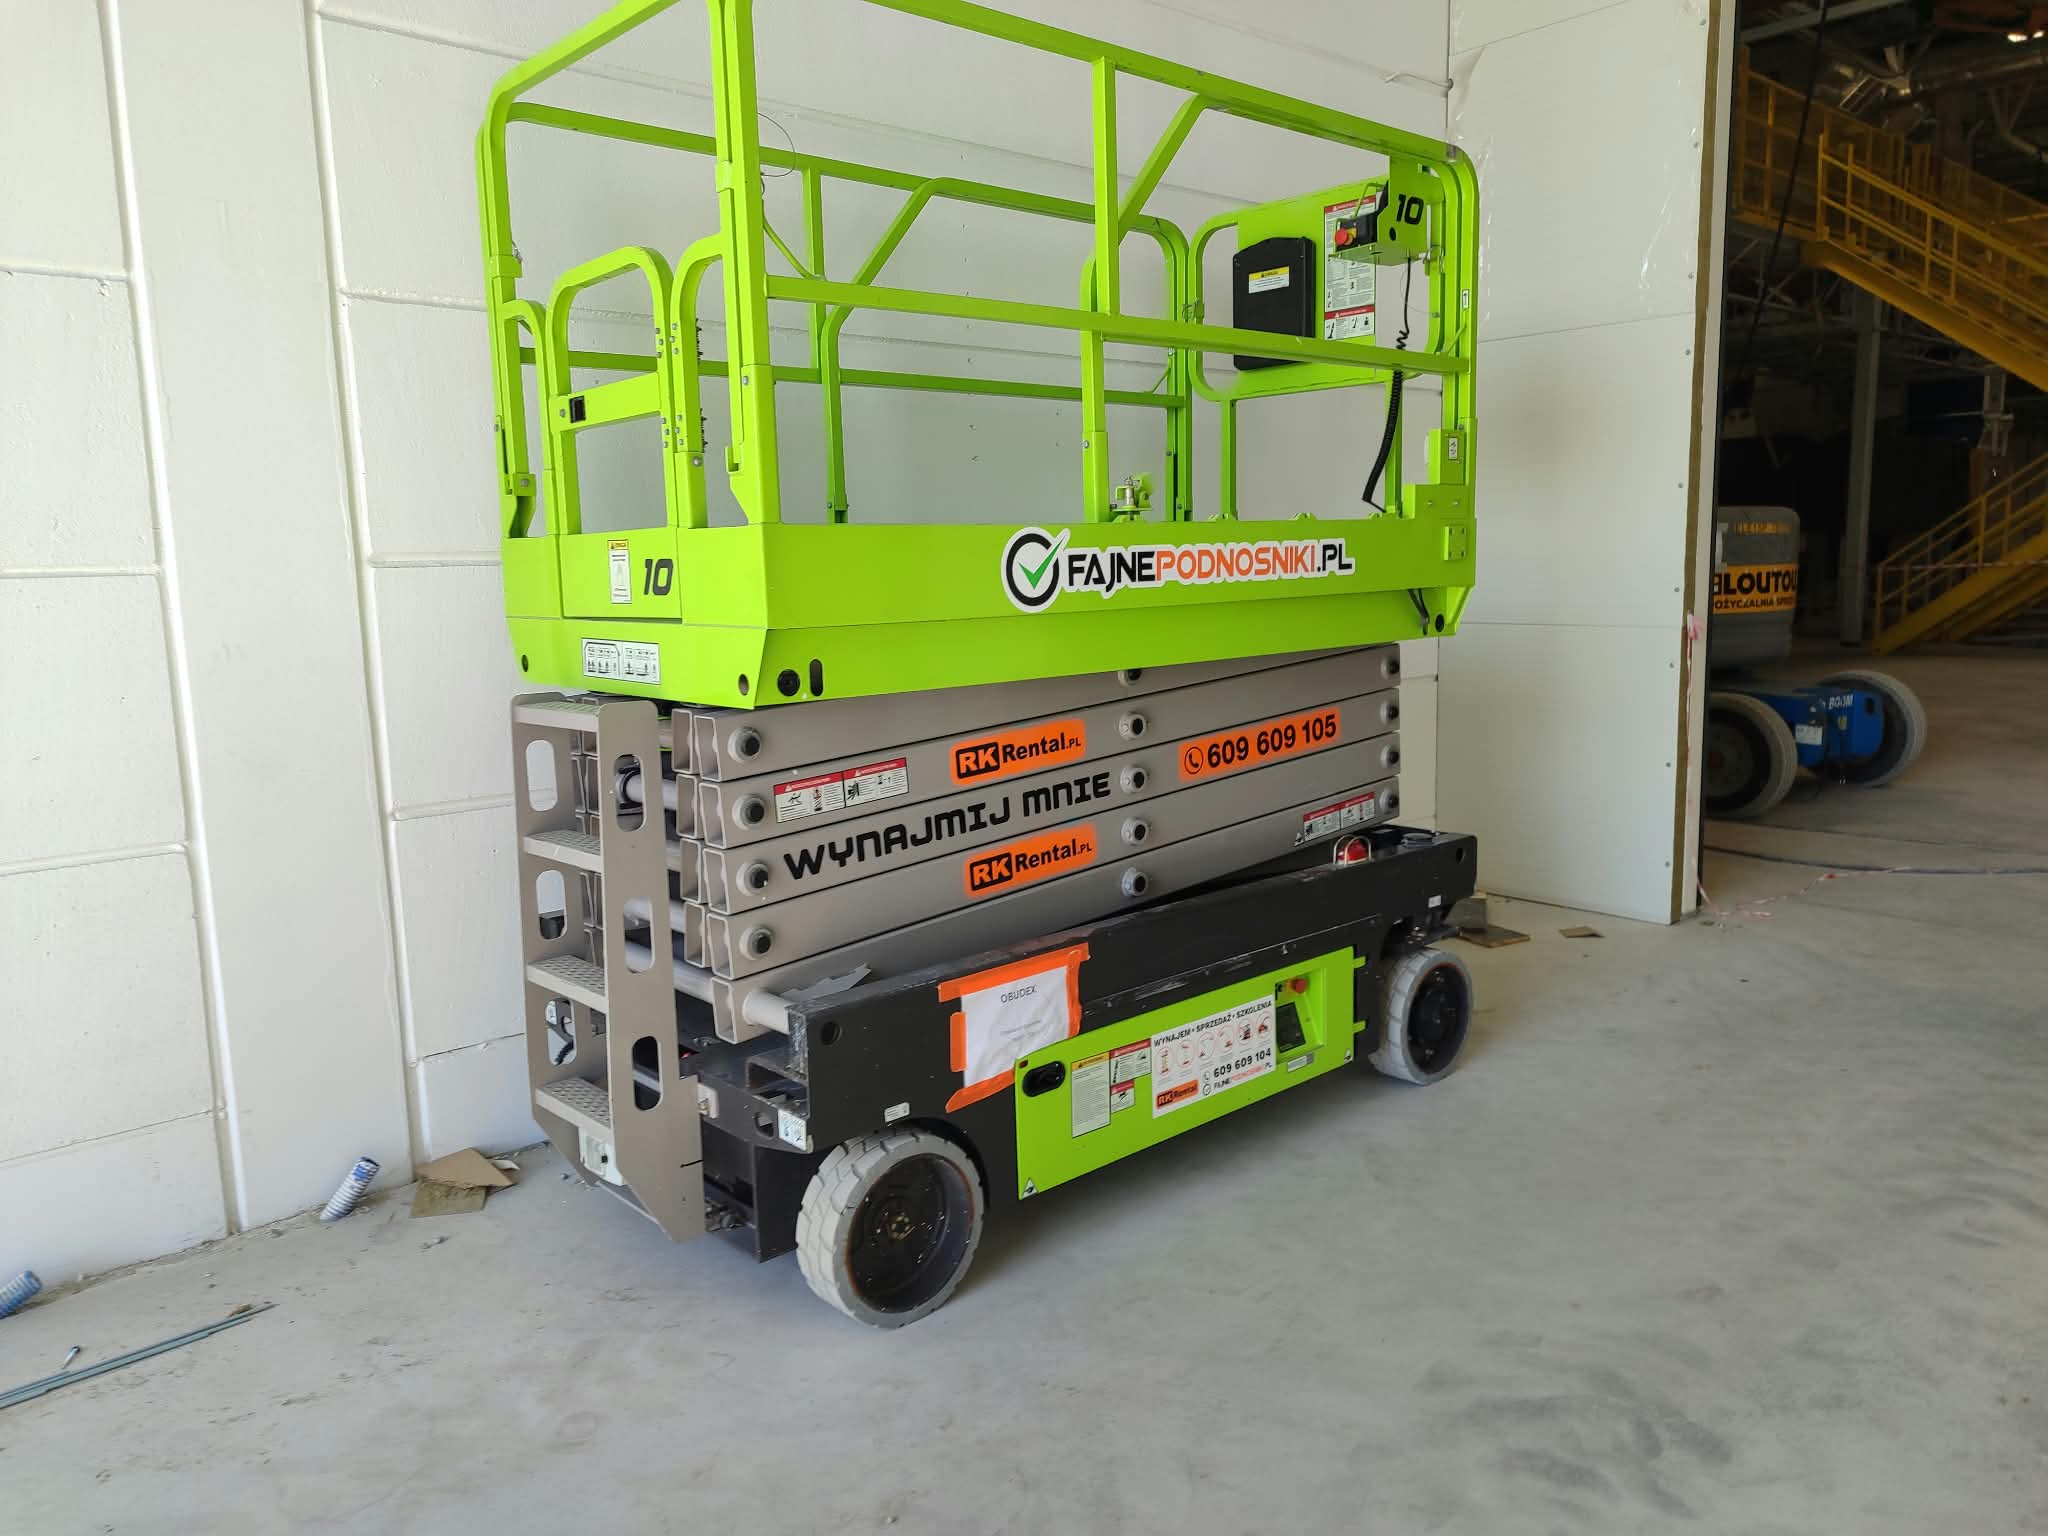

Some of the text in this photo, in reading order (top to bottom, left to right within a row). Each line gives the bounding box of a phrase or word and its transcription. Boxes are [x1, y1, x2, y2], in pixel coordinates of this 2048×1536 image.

[1397, 194, 1424, 225] 10
[643, 558, 674, 595] 10
[1068, 543, 1353, 592] FAJNEPODNOSNIKI.PL
[1207, 714, 1337, 768] 609 609 105
[957, 743, 999, 777] RK
[784, 772, 1111, 880] WYNAJMIJ MNIE
[971, 853, 1012, 890] RK
[1000, 984, 1038, 1003] OBUDEX
[1153, 1000, 1273, 1048] WYNAJEM SPRZEDAŻ SZKOLENIA
[1213, 1064, 1232, 1078] 609
[1234, 1056, 1253, 1070] 609
[1255, 1048, 1271, 1062] 104
